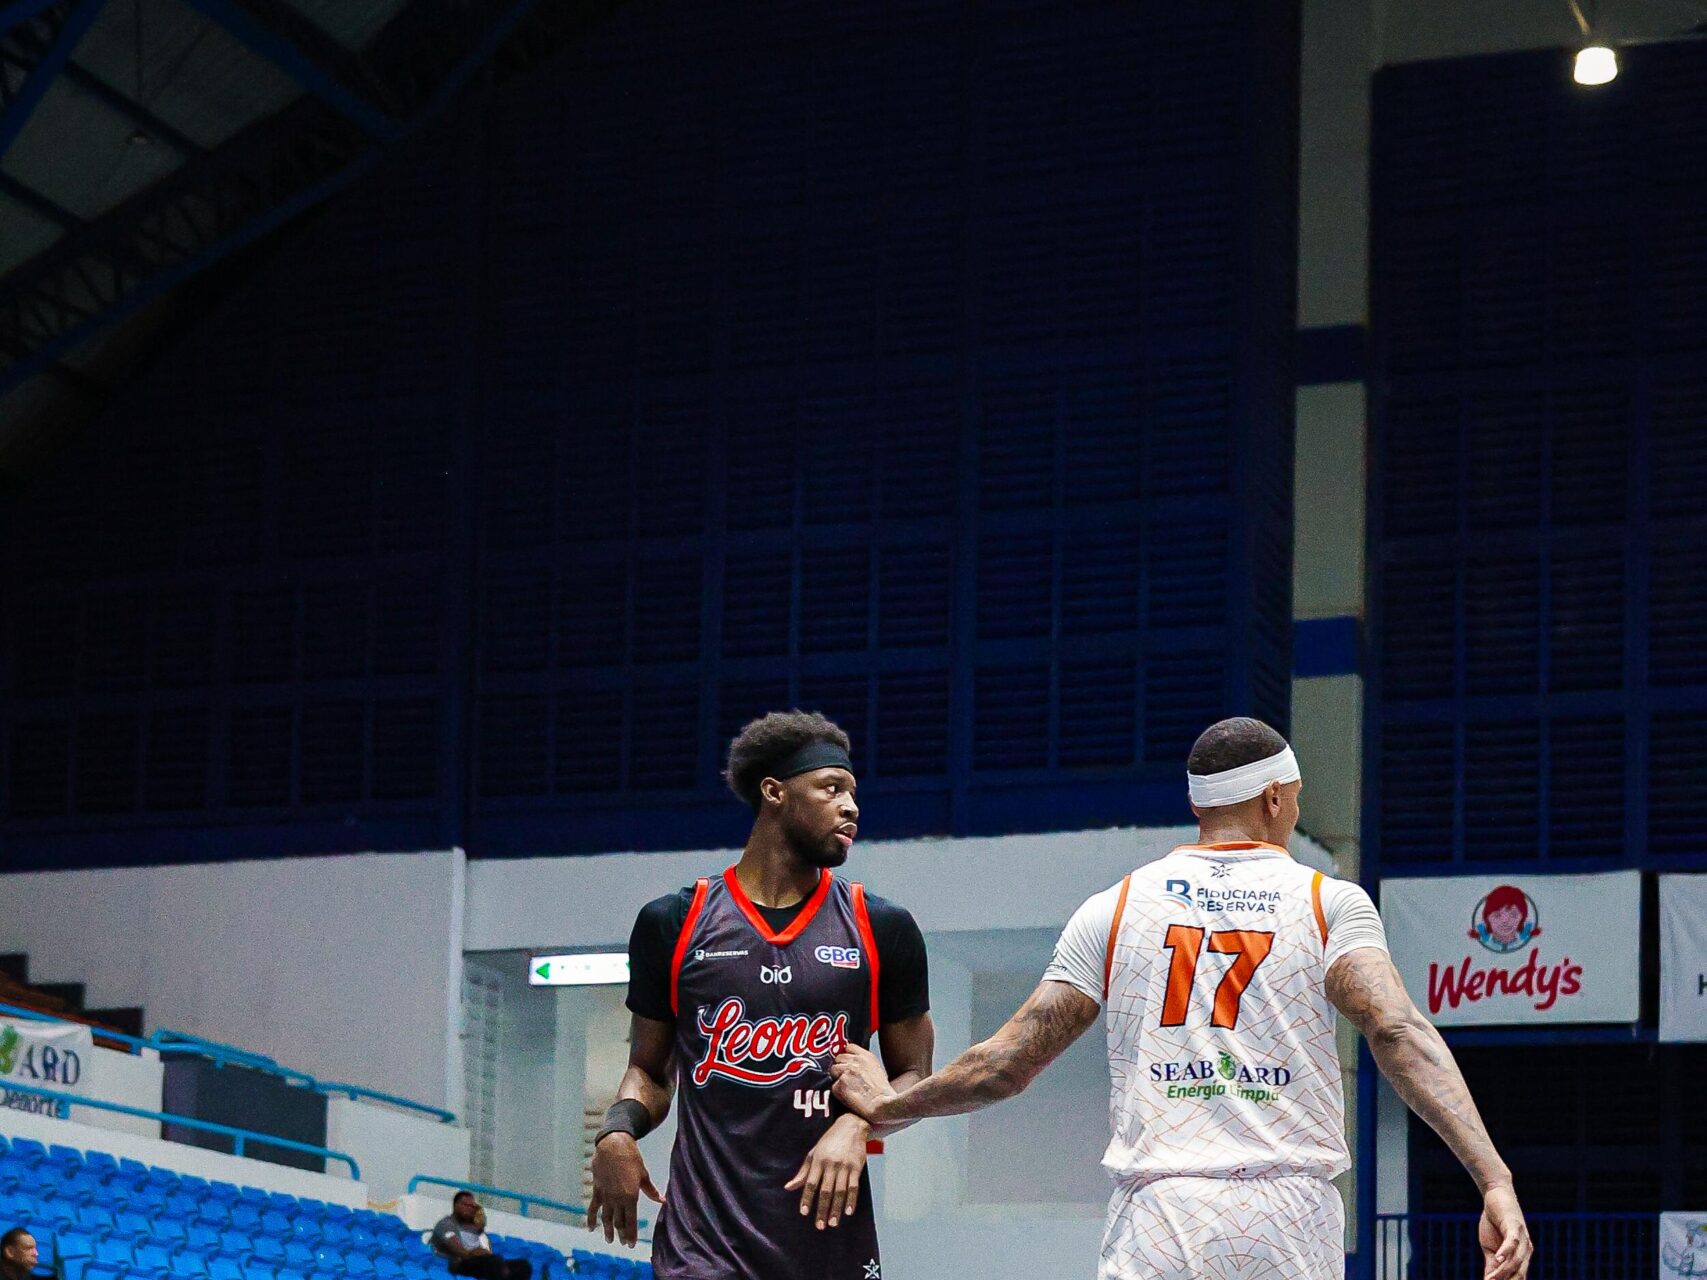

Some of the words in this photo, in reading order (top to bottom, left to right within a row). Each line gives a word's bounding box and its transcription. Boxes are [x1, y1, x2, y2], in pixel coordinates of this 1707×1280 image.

[1197, 888, 1281, 901] FIDUCIARIA
[1197, 900, 1276, 914] RESERVAS
[1160, 924, 1275, 1031] 17
[1428, 947, 1583, 1014] Wendy's
[693, 997, 850, 1086] Leones
[793, 1089, 831, 1118] 44
